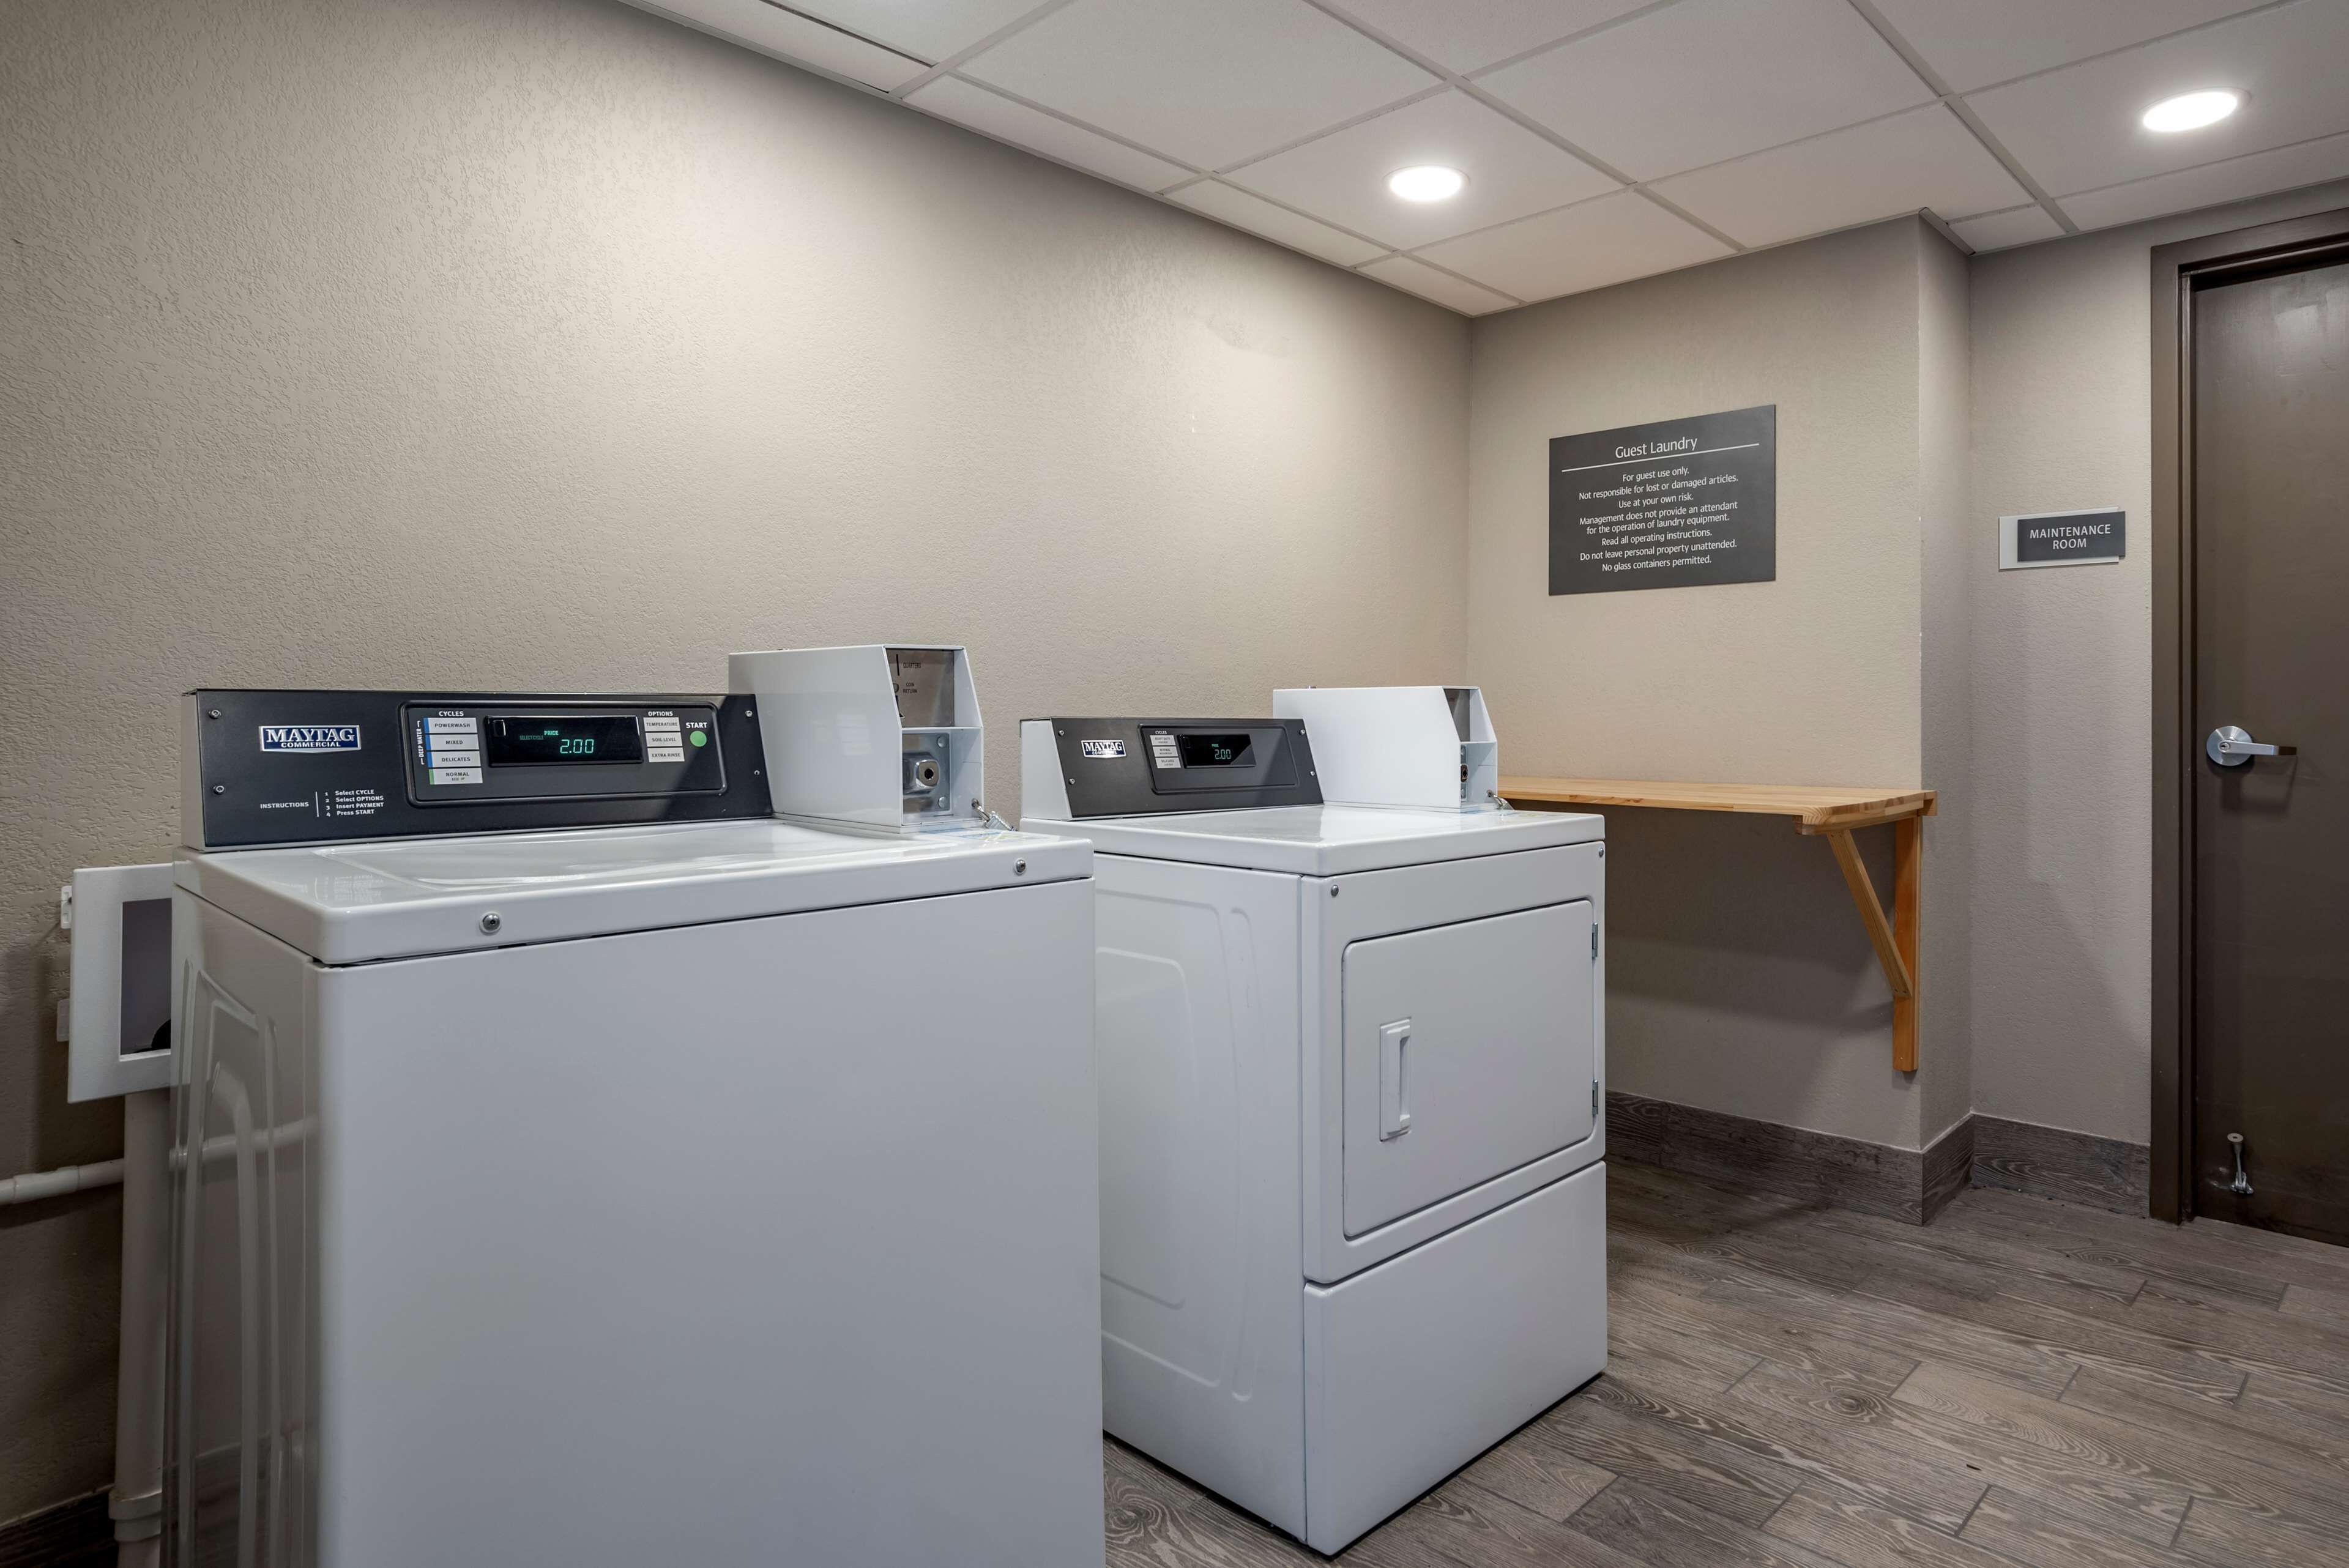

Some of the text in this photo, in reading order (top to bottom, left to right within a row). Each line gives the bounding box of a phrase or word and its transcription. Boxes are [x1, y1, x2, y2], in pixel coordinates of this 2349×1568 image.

[1615, 436, 1697, 458] Guest Laundry
[1636, 470, 1656, 482] guest
[1672, 466, 1689, 476] only.
[1593, 486, 1632, 499] responsible
[1646, 483, 1659, 492] lost
[1671, 477, 1707, 488] damaged
[1708, 474, 1738, 485] articles.
[1642, 497, 1659, 507] your
[1678, 492, 1694, 501] risk.
[1579, 514, 1624, 525] Management
[1626, 511, 1643, 520] does
[1645, 510, 1657, 518] not
[1659, 507, 1687, 519] provide
[1700, 501, 1738, 513] attendant
[1599, 525, 1610, 533] the
[1612, 521, 1645, 533] operation
[1647, 519, 1655, 529] of
[1656, 518, 1685, 527] laundry
[1686, 513, 1730, 526] equipment.
[1602, 529, 1712, 546] Read all operating instructions.
[2030, 524, 2111, 539] MAINTENANCE
[1591, 551, 1603, 560] not
[1625, 546, 1655, 558] personal
[1656, 544, 1689, 555] property
[1691, 538, 1737, 551] unattended.
[2053, 538, 2087, 549] ROOM
[1614, 562, 1631, 572] glass
[1633, 559, 1670, 569] containers
[1672, 554, 1712, 568] permitted.
[266, 729, 355, 743] MAYTAG
[560, 739, 594, 753] 2.00
[1084, 742, 1122, 751] MAYTAG
[1215, 749, 1231, 760] 2.00
